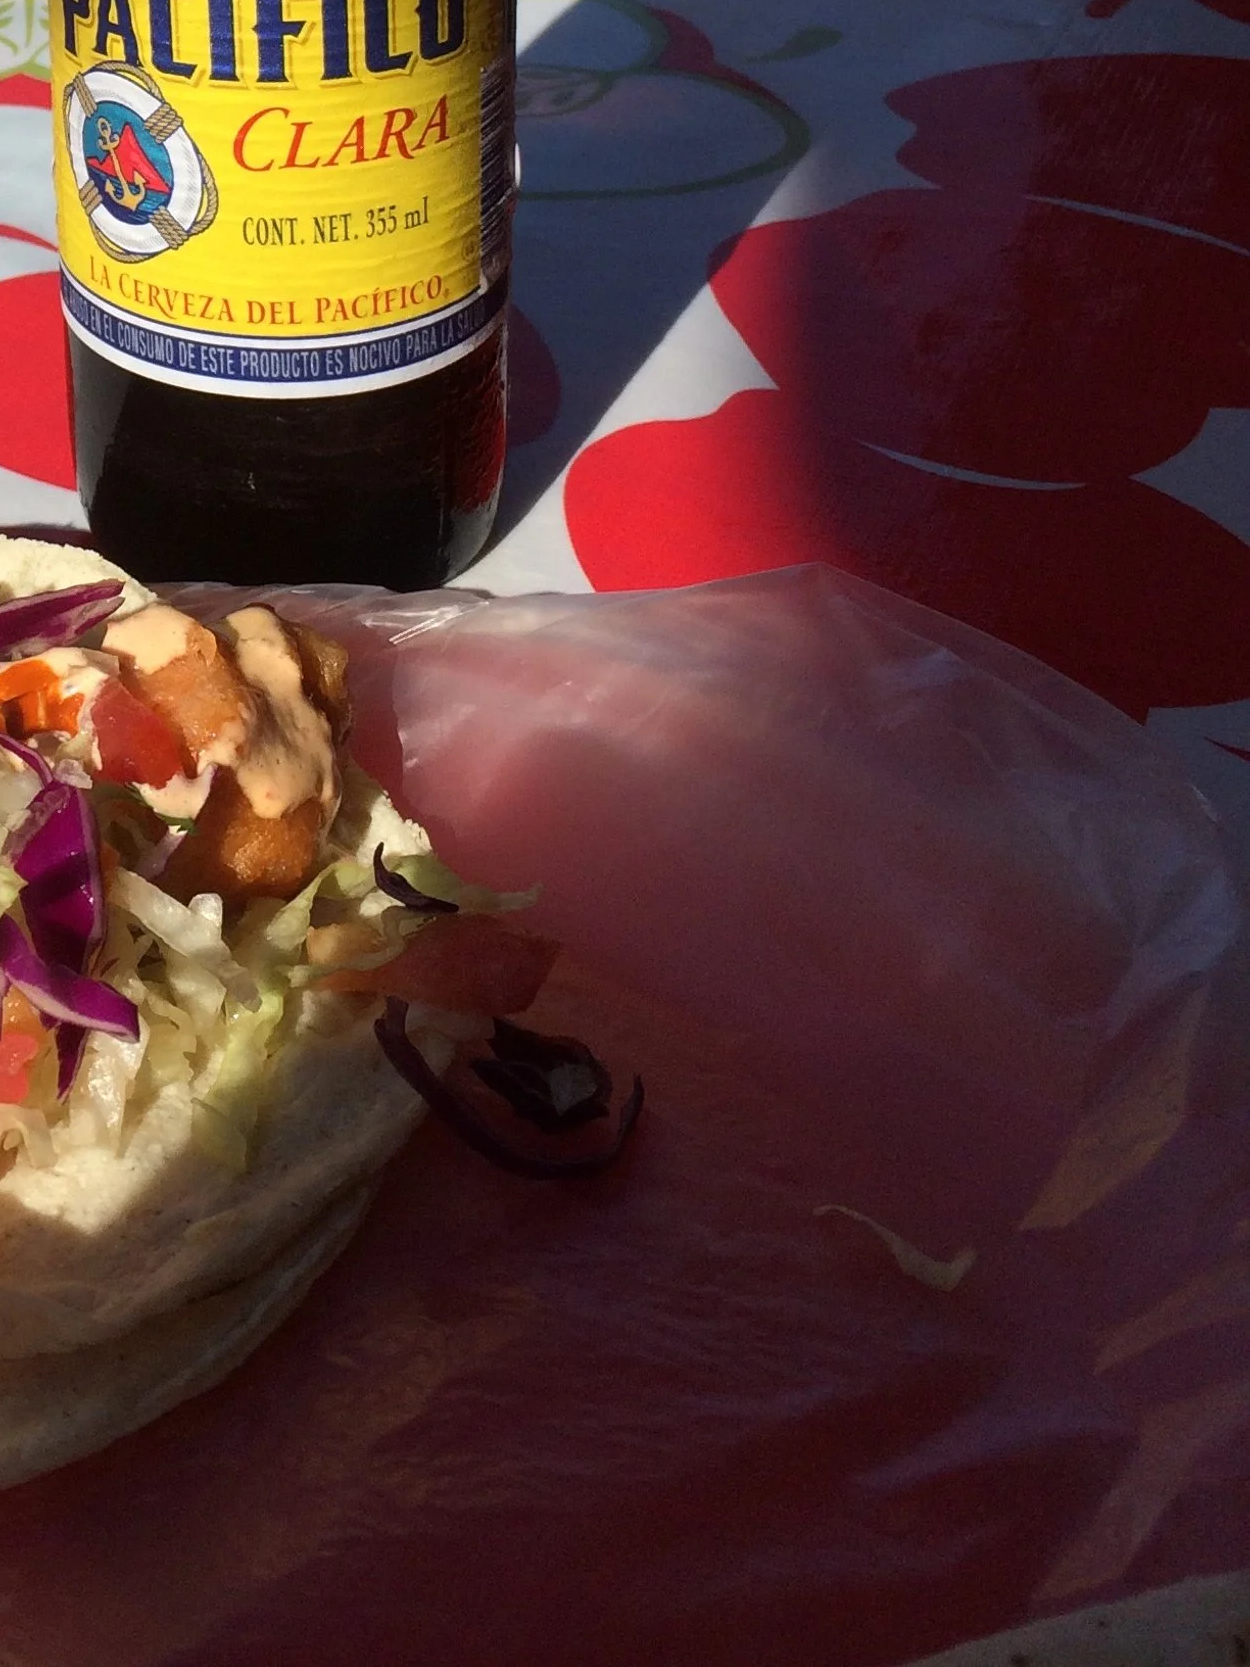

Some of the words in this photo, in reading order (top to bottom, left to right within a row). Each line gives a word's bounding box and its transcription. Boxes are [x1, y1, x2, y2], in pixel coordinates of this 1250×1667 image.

[232, 93, 450, 172] CLARA
[242, 216, 305, 246] CONT.
[312, 213, 359, 244] NET.
[365, 204, 397, 238] 355
[403, 195, 430, 230] ml
[89, 253, 111, 290] LA
[118, 272, 235, 323] CERVEZA
[246, 300, 303, 325] DEL
[90, 306, 102, 336] EN
[103, 313, 115, 343] EL
[117, 321, 174, 365] CONSUMO
[178, 340, 196, 369] DE
[201, 345, 235, 375] ESTE
[240, 349, 320, 379] PRODUCTO
[325, 348, 344, 376] ES
[350, 337, 400, 373] NOCIVO
[406, 325, 437, 361] PARA
[440, 316, 454, 347] LA
